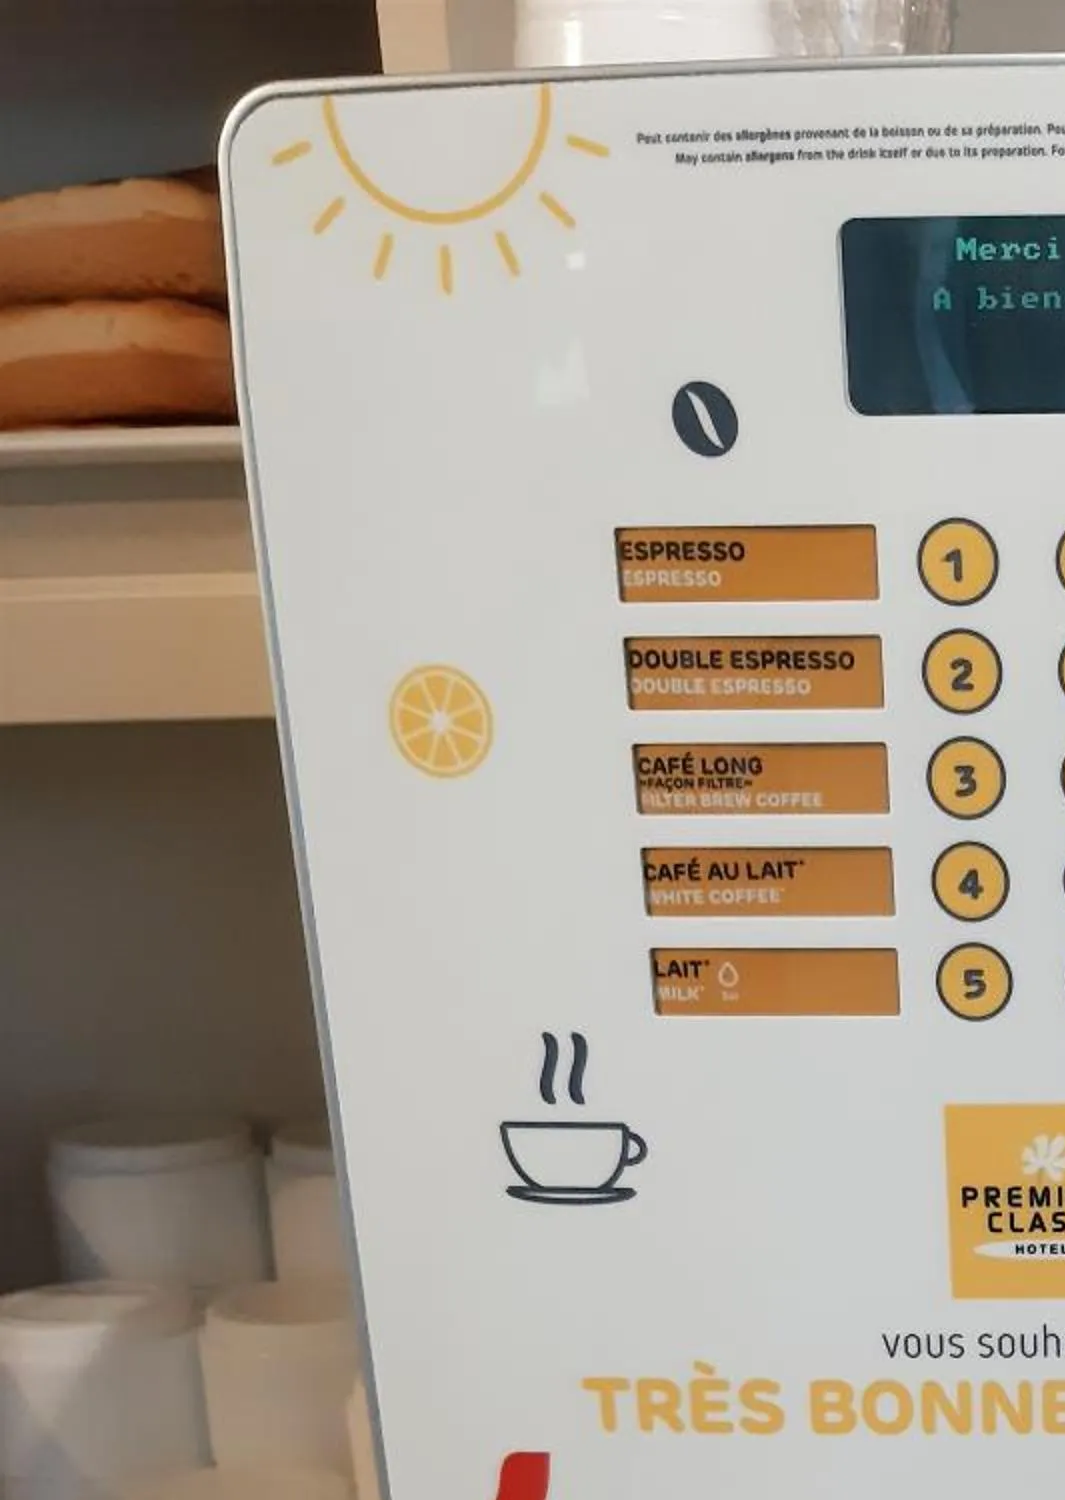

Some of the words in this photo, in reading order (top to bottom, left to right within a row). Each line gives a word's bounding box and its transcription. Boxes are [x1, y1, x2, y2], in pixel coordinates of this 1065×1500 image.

[637, 132, 662, 144] Peut
[666, 131, 710, 143] contenir
[714, 130, 732, 142] des
[736, 128, 790, 142] allergènes
[794, 128, 848, 141] provenant
[852, 127, 866, 139] de
[870, 127, 879, 138] la
[882, 126, 924, 136] boisson
[928, 128, 941, 136] ou
[944, 125, 958, 136] de
[675, 153, 698, 166] May
[702, 152, 742, 164] contain
[746, 151, 794, 164] allergens
[797, 150, 822, 160] from
[826, 149, 844, 160] the
[848, 148, 876, 160] drink
[879, 148, 907, 159] itself
[911, 150, 921, 159] or
[926, 148, 946, 158] due
[950, 149, 960, 159] to
[964, 146, 978, 158] its
[956, 236, 1062, 260] Merci
[932, 287, 952, 311] A
[620, 541, 745, 562] ESPRESSO
[940, 548, 963, 582] 1
[622, 570, 722, 588] ESPRESSO
[630, 650, 722, 670] DOUBLE
[731, 651, 855, 671] ESPRESSO
[630, 677, 705, 694] DOUBLE
[712, 678, 811, 696] ESPRESSO
[950, 658, 974, 691] 2
[639, 752, 694, 774] CAFÉ
[702, 757, 762, 775] LONG
[954, 766, 976, 796] 3
[701, 793, 750, 807] BREW
[756, 792, 823, 806] COFFEE
[644, 858, 700, 882] CAFÉ
[708, 863, 739, 880] AU
[958, 869, 984, 900] 4
[963, 969, 986, 1000] 5
[882, 1332, 965, 1359] vous
[581, 1361, 787, 1435] TRÈS
